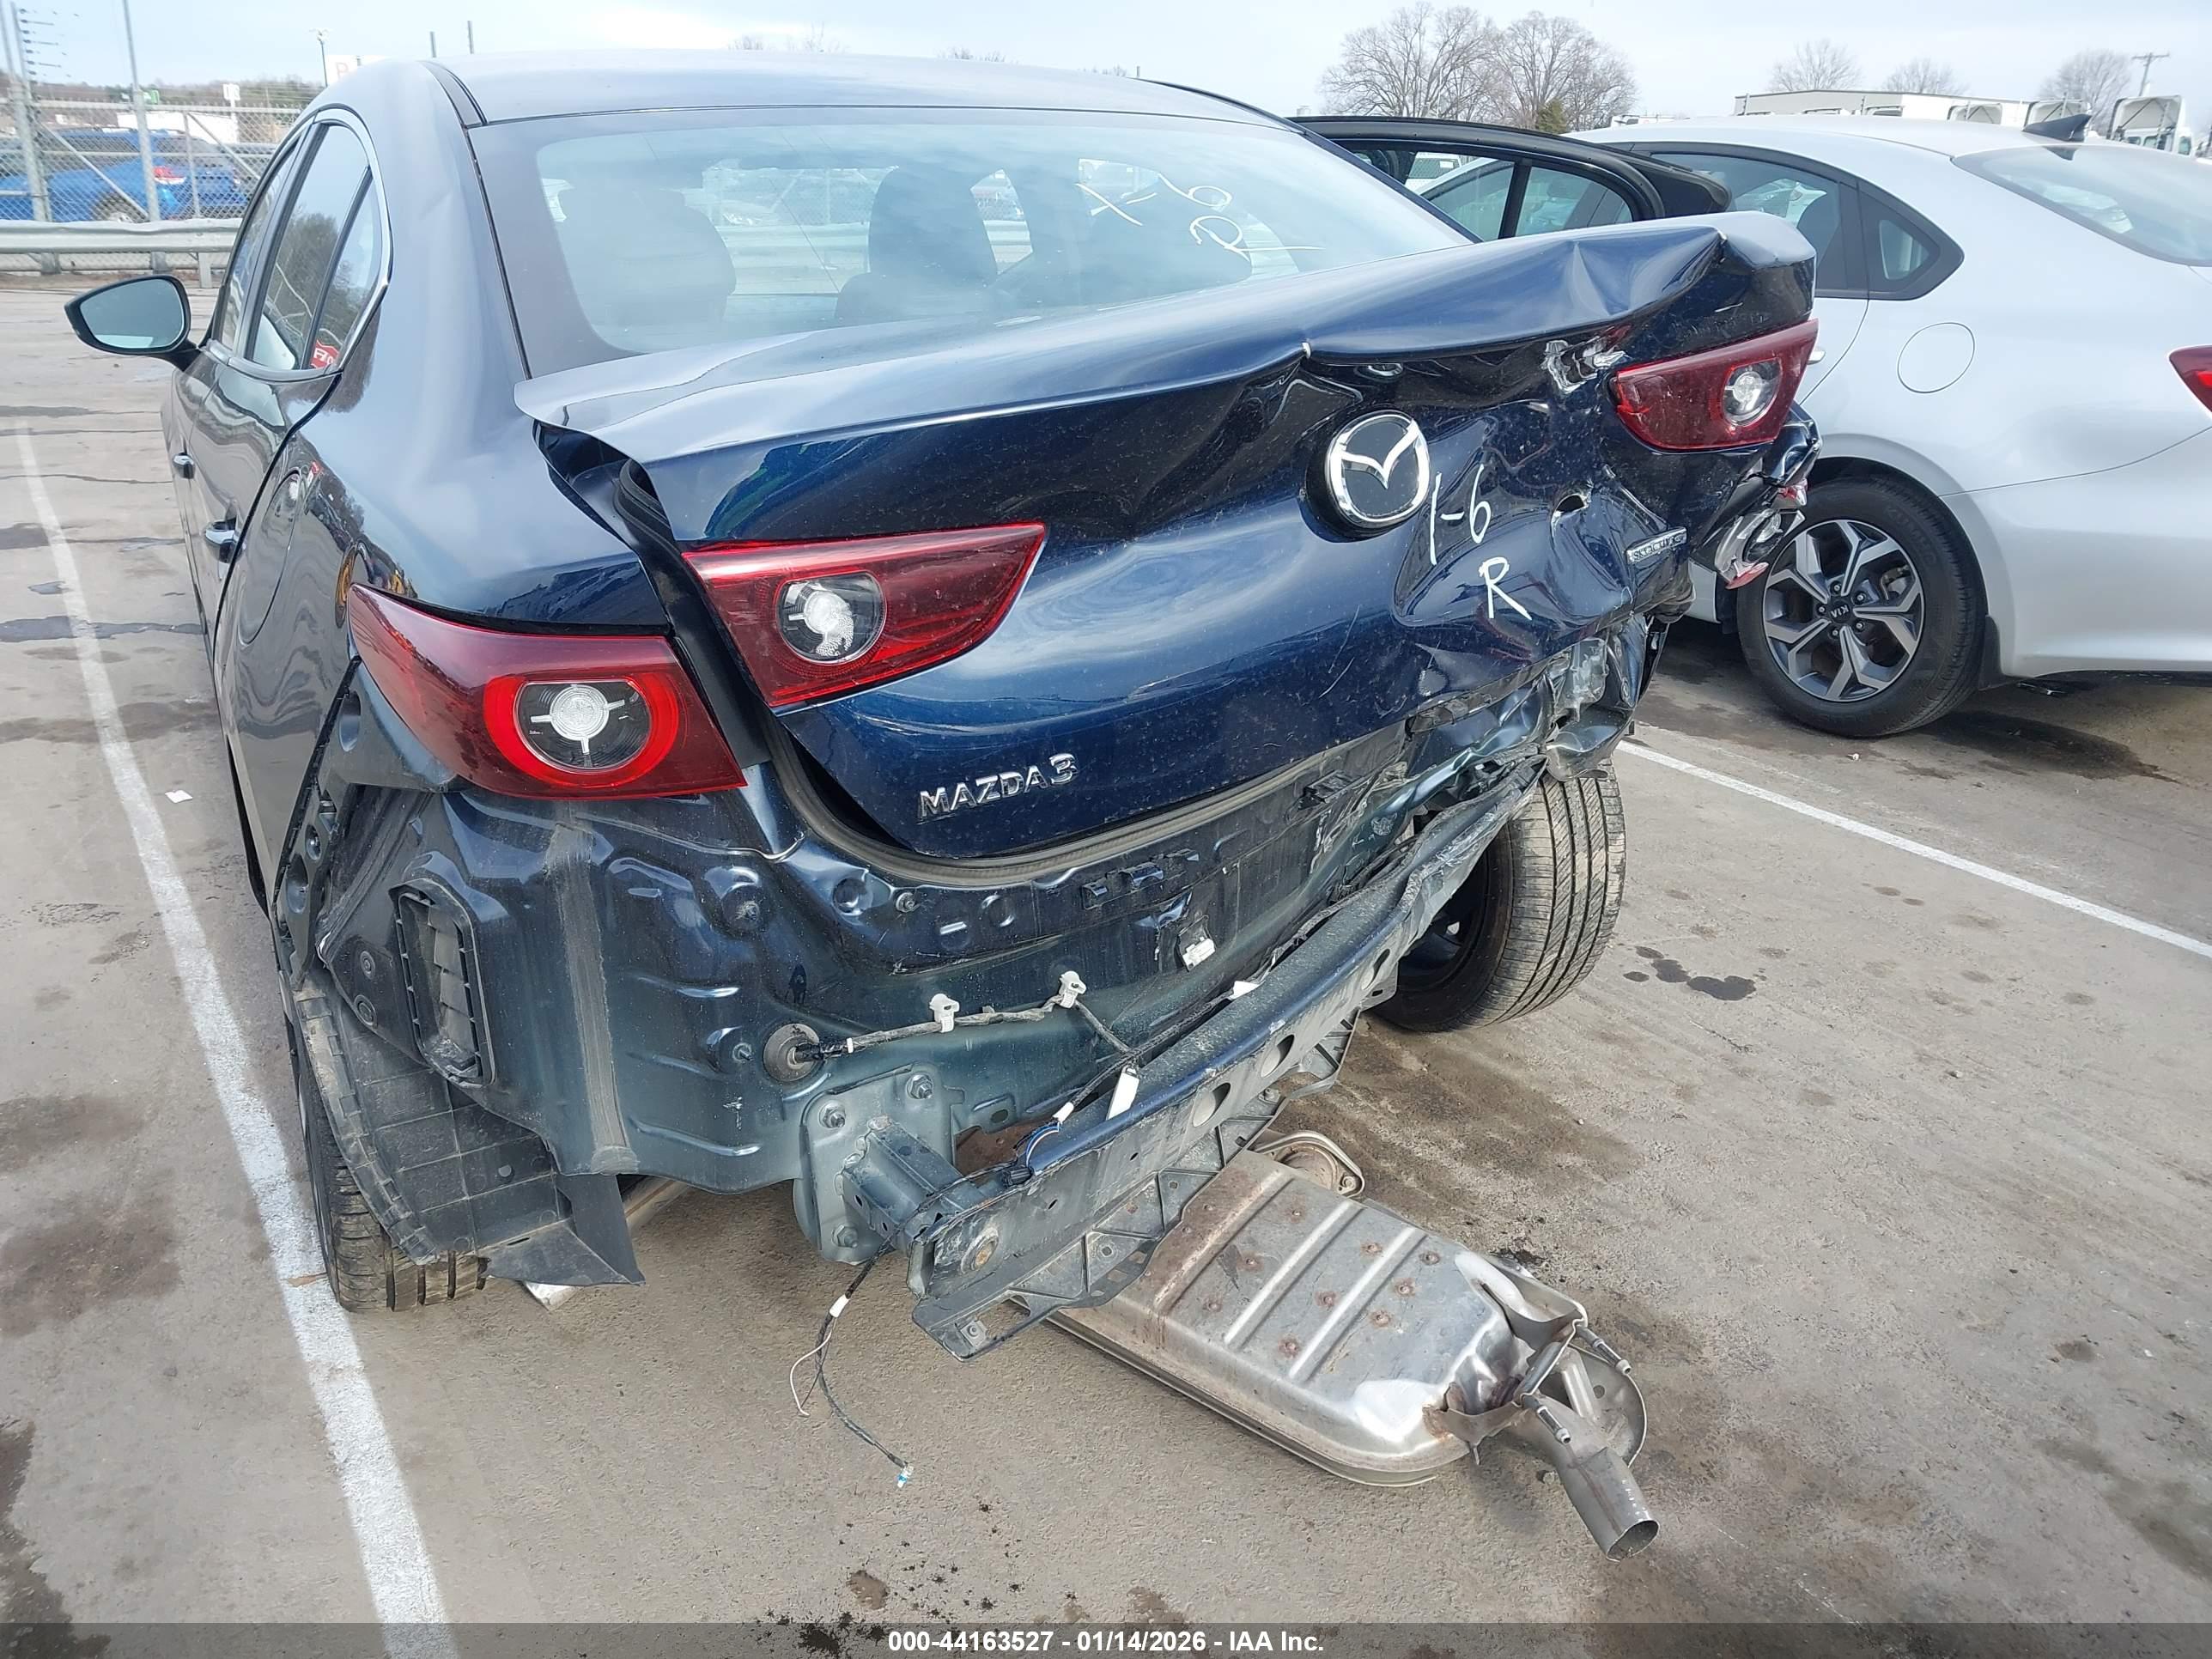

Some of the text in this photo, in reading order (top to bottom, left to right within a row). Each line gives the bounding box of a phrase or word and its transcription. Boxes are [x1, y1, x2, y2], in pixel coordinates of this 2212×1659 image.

[1430, 464, 1492, 566] 1-6
[1478, 556, 1533, 621] R
[1831, 605, 1850, 617] KIA
